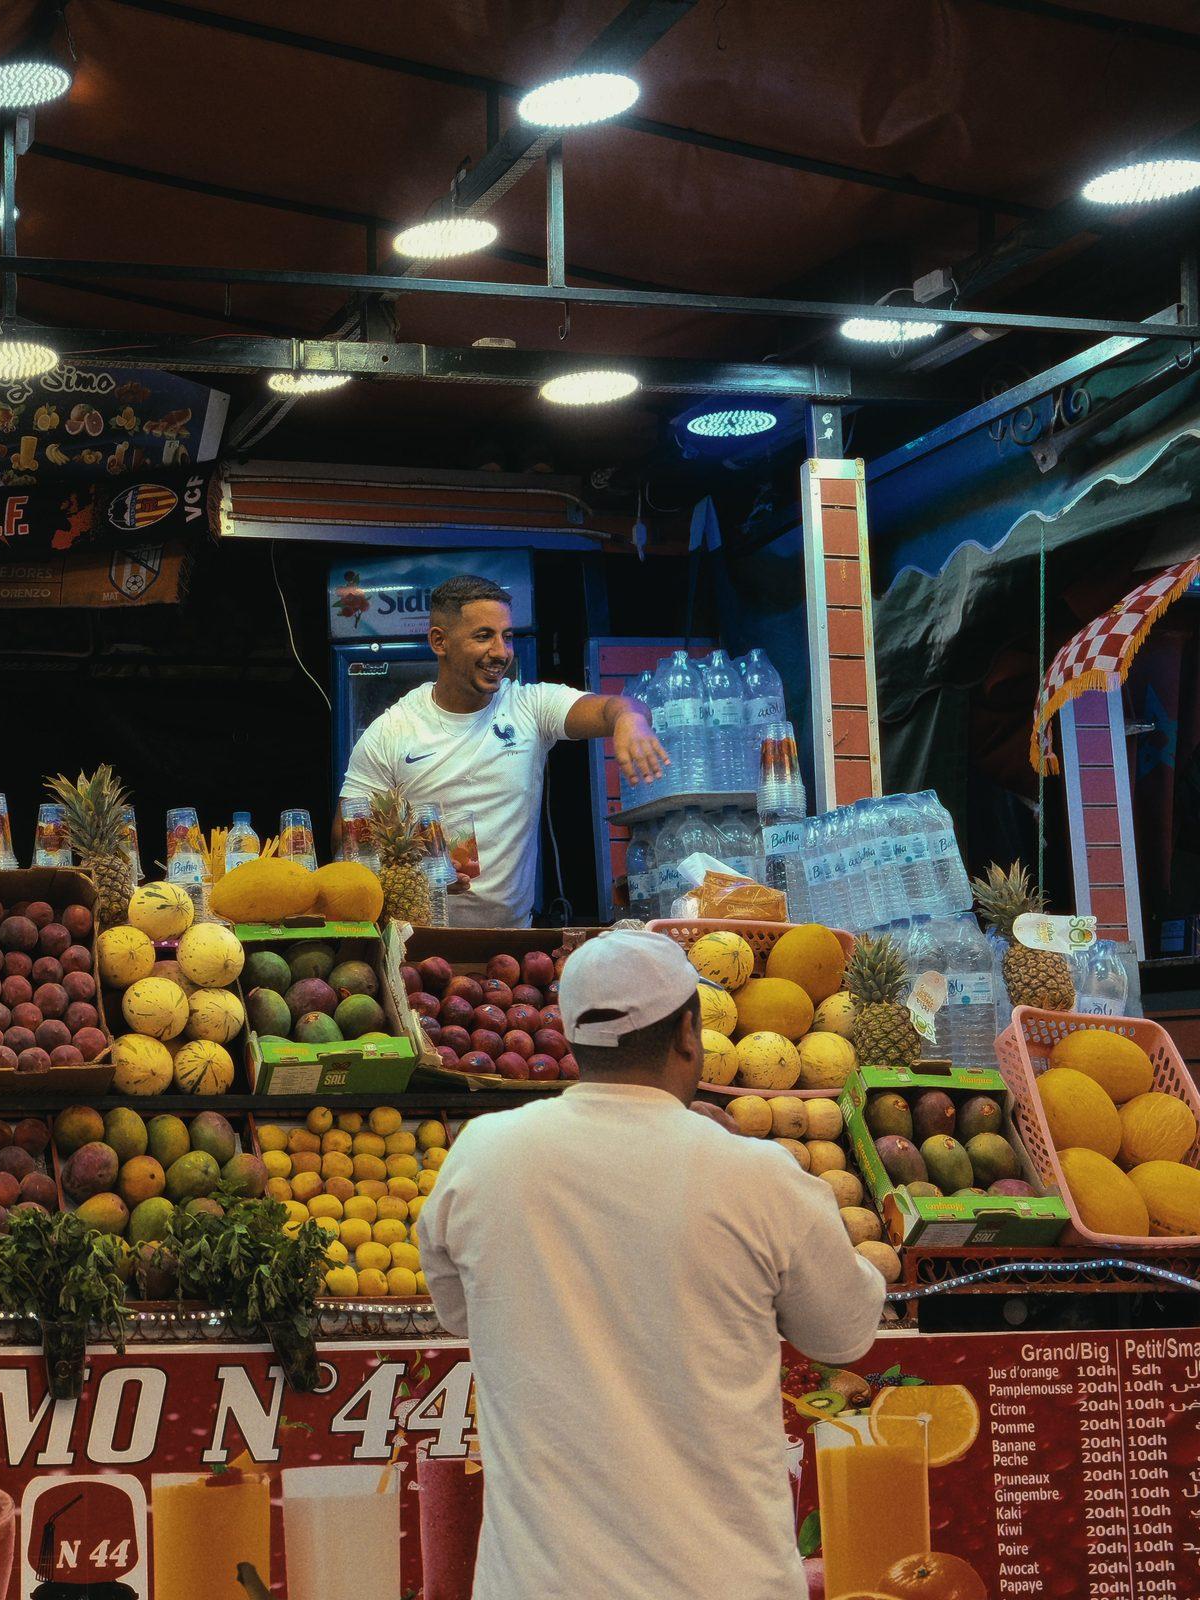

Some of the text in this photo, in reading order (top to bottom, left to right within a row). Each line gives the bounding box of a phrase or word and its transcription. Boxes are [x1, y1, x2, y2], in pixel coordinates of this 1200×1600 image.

[184, 475, 204, 523] VCF
[770, 830, 800, 848] Bahia
[1020, 1342, 1110, 1363] Grand/Big
[988, 1364, 1161, 1380] Jus d'orange 10dh 5dh
[989, 1382, 1073, 1398] Pamplemousse
[1078, 1382, 1118, 1393] 20dh
[1124, 1380, 1163, 1391] 10dh
[990, 1403, 1026, 1416] Citron
[1079, 1400, 1119, 1411] 20dh
[1126, 1399, 1165, 1410] 10dh
[991, 1417, 1166, 1434] Pomme 20dh 10dh
[992, 1435, 1167, 1452] Banane 20dh 10dh
[993, 1449, 1168, 1466] Peche 20dh 10dh
[994, 1468, 1169, 1486] Pruneaux 20dh 10dh
[994, 1489, 1060, 1504] Gingembre
[1084, 1489, 1124, 1501] 20dh
[1130, 1487, 1170, 1499] 10dh
[996, 1505, 1171, 1520] Kaki 20dh 10dh
[997, 1522, 1172, 1537] Kiwi 20dh 10dh
[56, 1539, 131, 1569] N 44
[998, 1542, 1029, 1556] Poire
[1087, 1542, 1127, 1554] 20dh
[1134, 1540, 1174, 1553] 10dh
[999, 1560, 1175, 1576] Avocat 20dh 10dh
[1000, 1579, 1177, 1594] Papaye 20dh 10dh
